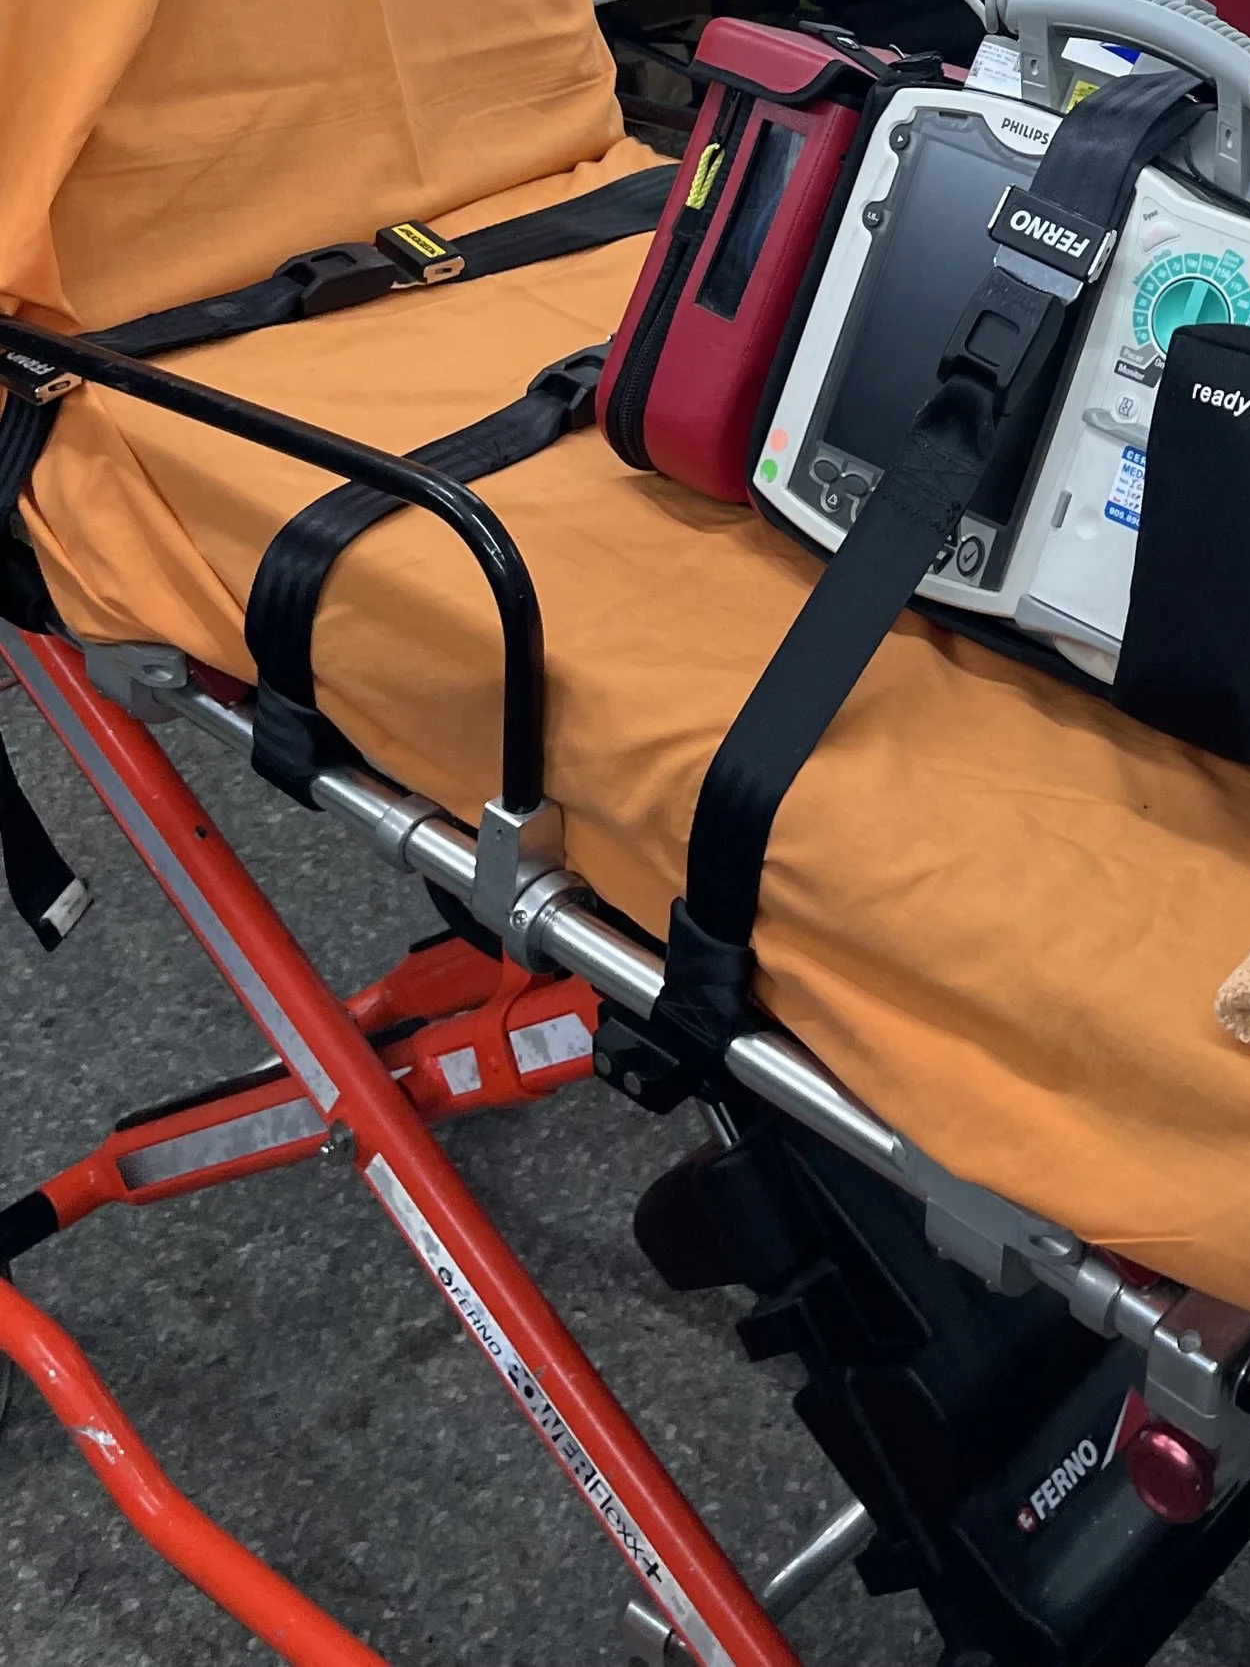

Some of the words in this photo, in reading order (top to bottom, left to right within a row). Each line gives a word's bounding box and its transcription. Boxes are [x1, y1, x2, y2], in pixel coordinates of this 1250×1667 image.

[1001, 117, 1050, 145] PHILIPS
[1010, 209, 1091, 258] FERNO
[450, 1286, 502, 1357] FERNO
[1030, 1439, 1098, 1520] FERNO
